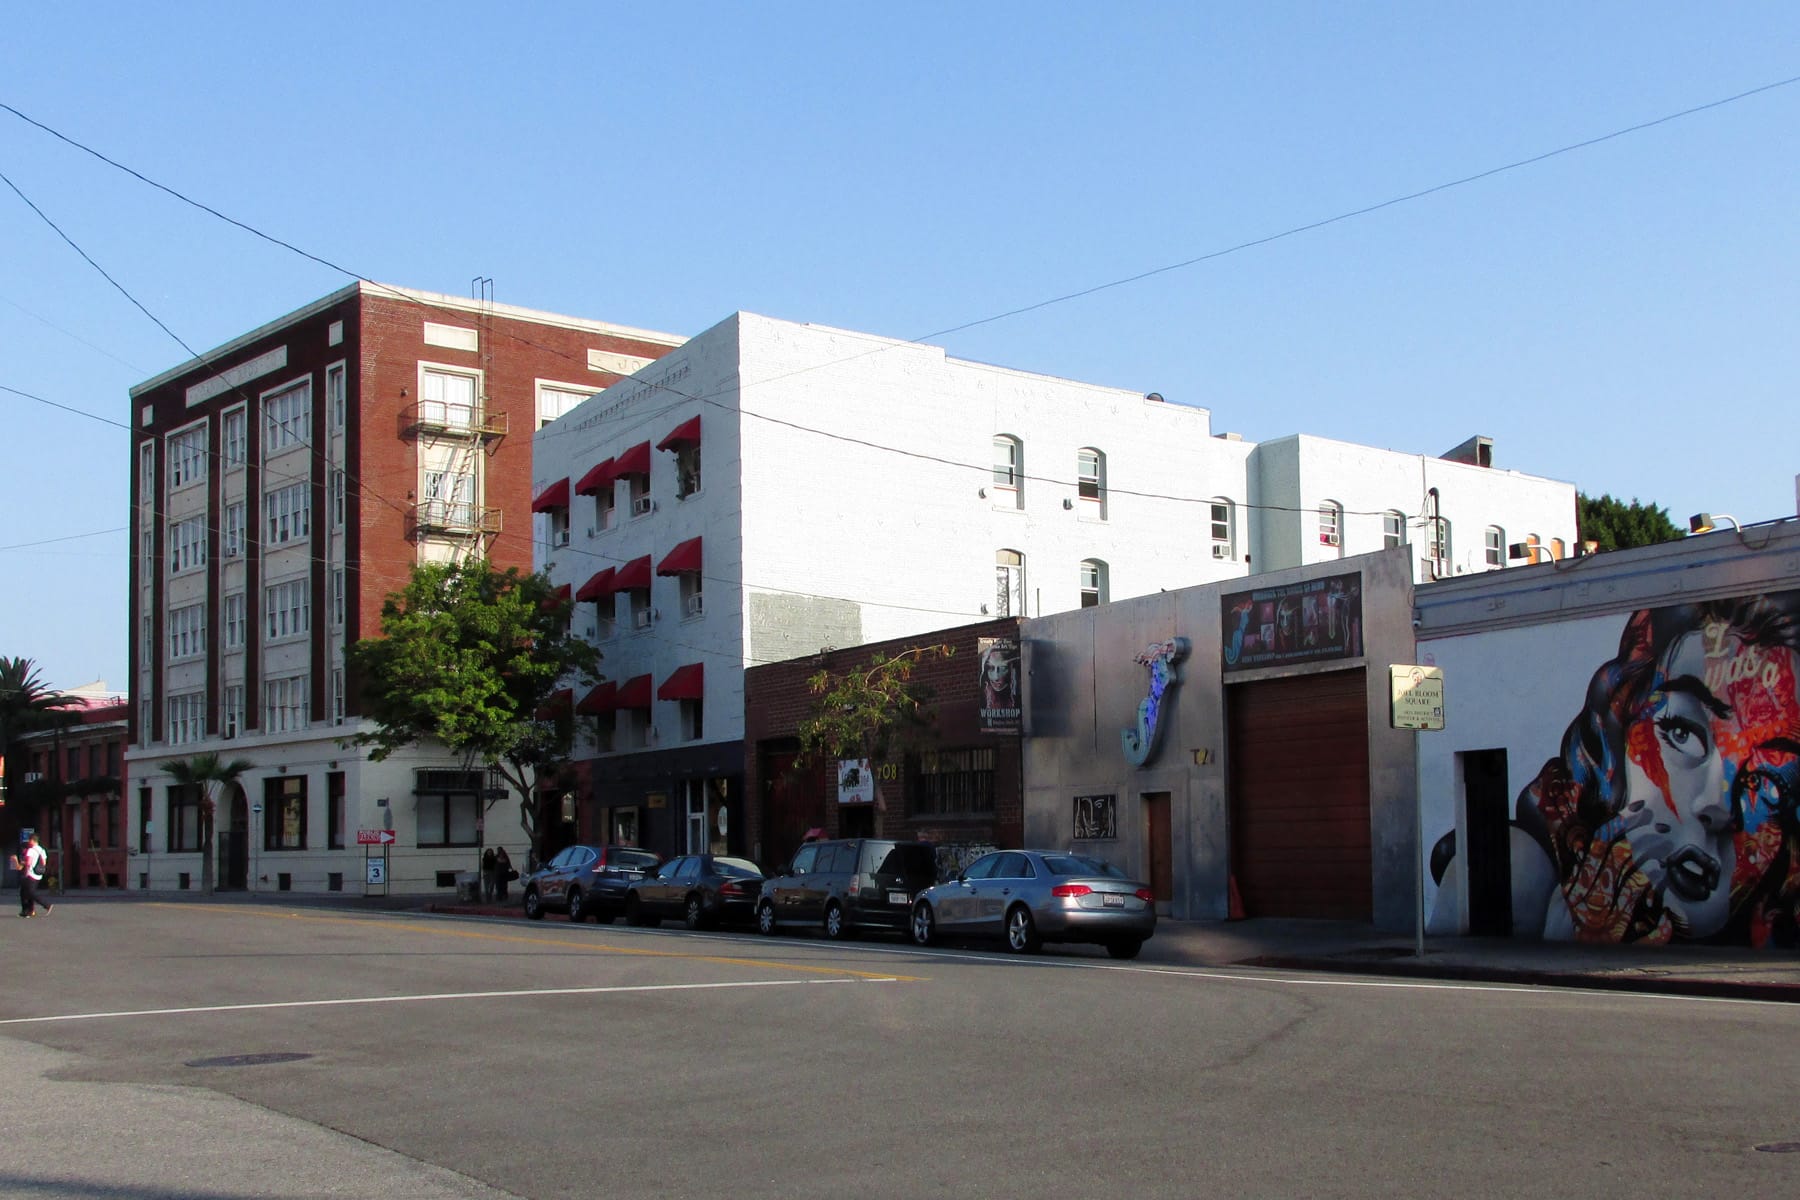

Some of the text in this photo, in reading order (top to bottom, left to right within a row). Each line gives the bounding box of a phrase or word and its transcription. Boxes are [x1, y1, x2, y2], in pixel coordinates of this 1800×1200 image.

[1704, 623, 1730, 658] I
[1704, 645, 1781, 692] was a
[980, 707, 1020, 718] WORKSHOP
[373, 868, 380, 878] 3
